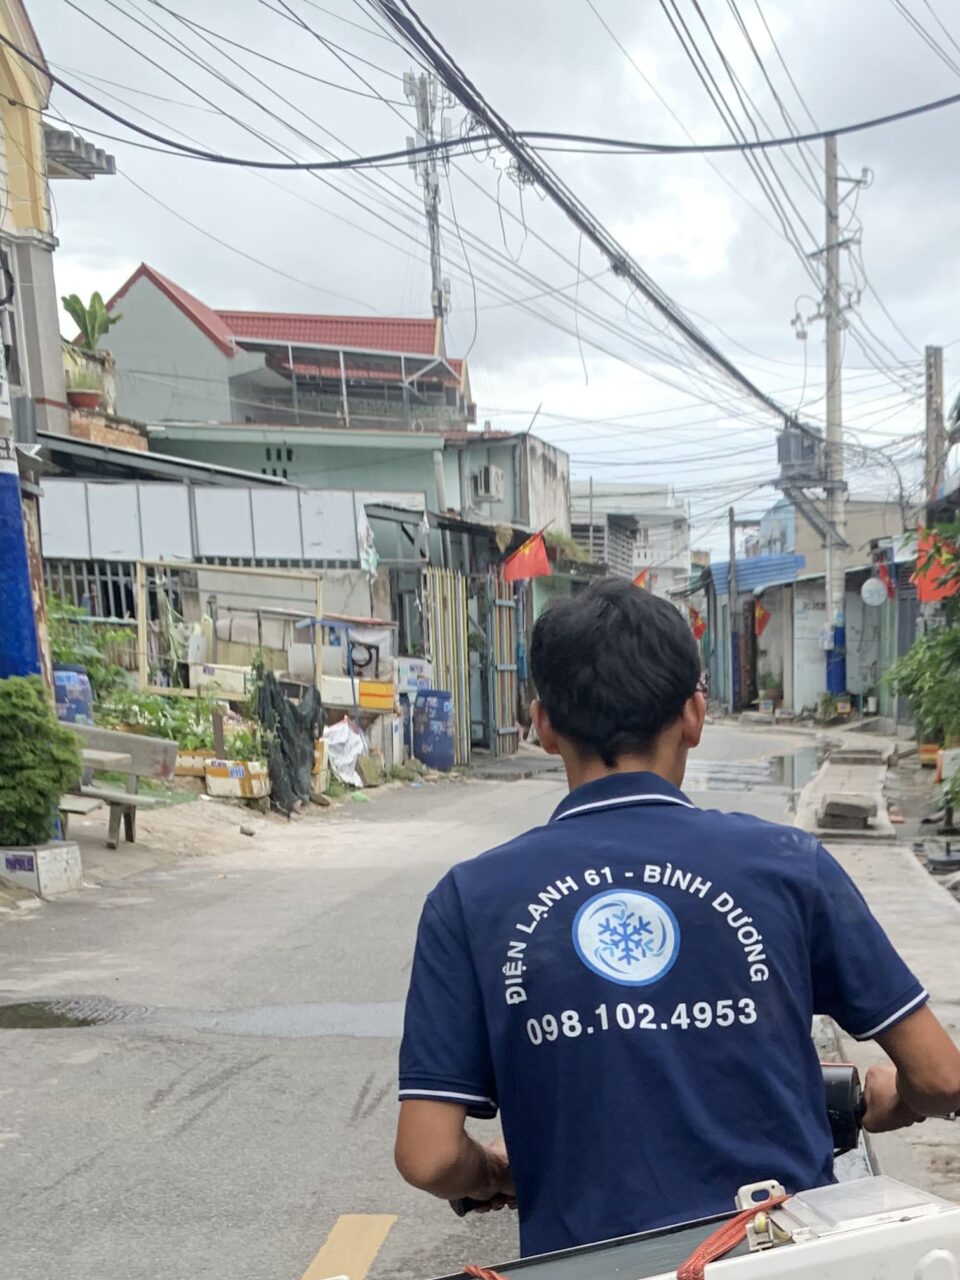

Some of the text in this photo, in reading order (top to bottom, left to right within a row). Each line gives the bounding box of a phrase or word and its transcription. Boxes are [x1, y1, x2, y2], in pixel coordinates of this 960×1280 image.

[502, 941, 528, 1005] ĐIỆN
[515, 875, 580, 935] LẠNH
[583, 866, 614, 886] 61
[643, 862, 713, 899] BÌNH
[711, 892, 770, 983] DƯƠNG
[526, 997, 758, 1046] 098.102.4953
